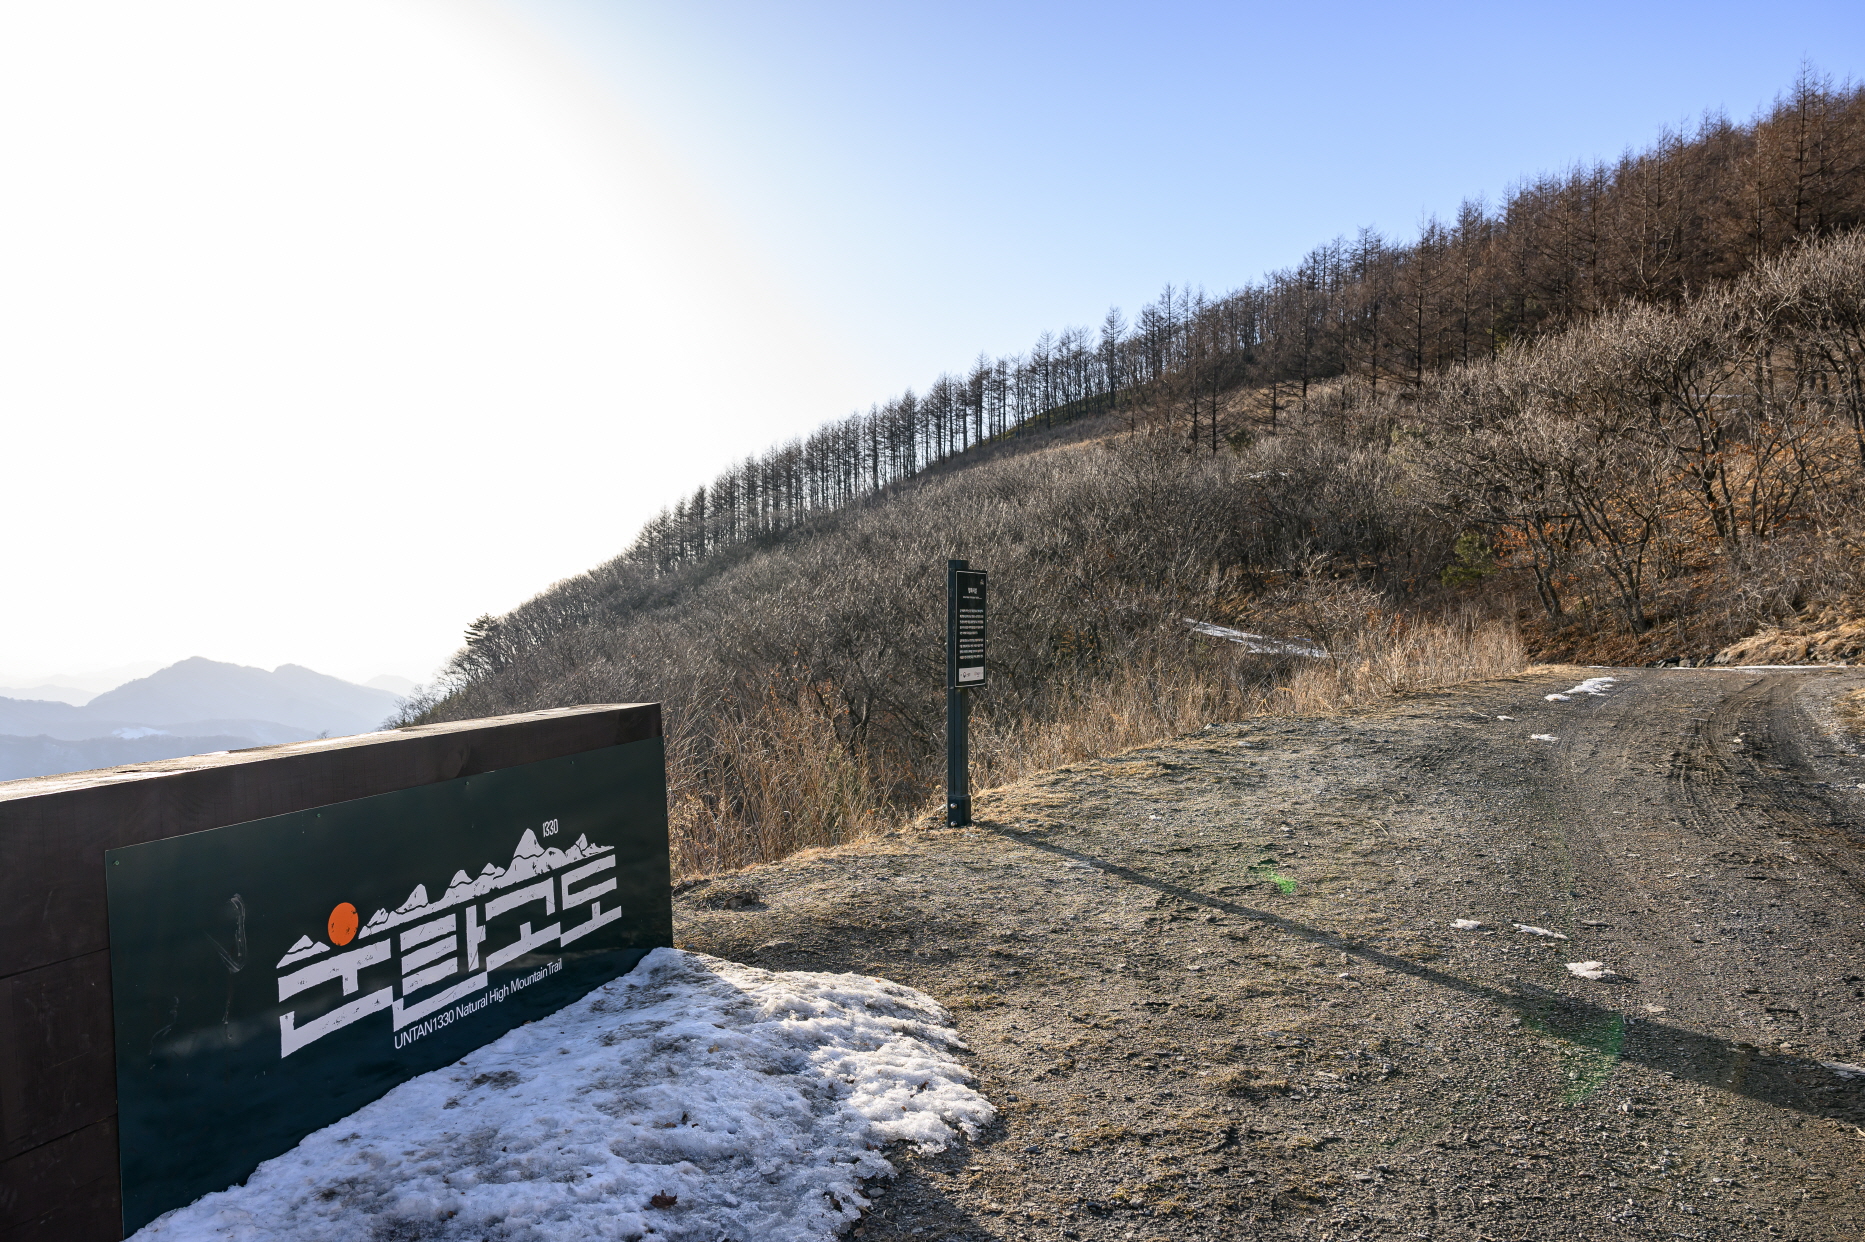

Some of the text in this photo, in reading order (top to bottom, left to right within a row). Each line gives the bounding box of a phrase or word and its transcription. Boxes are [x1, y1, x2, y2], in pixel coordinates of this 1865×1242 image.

[542, 818, 559, 838] 1330
[277, 854, 622, 1059] 운탄고도
[394, 957, 563, 1050] UNTAN1330 Natural High Mountain Trail
